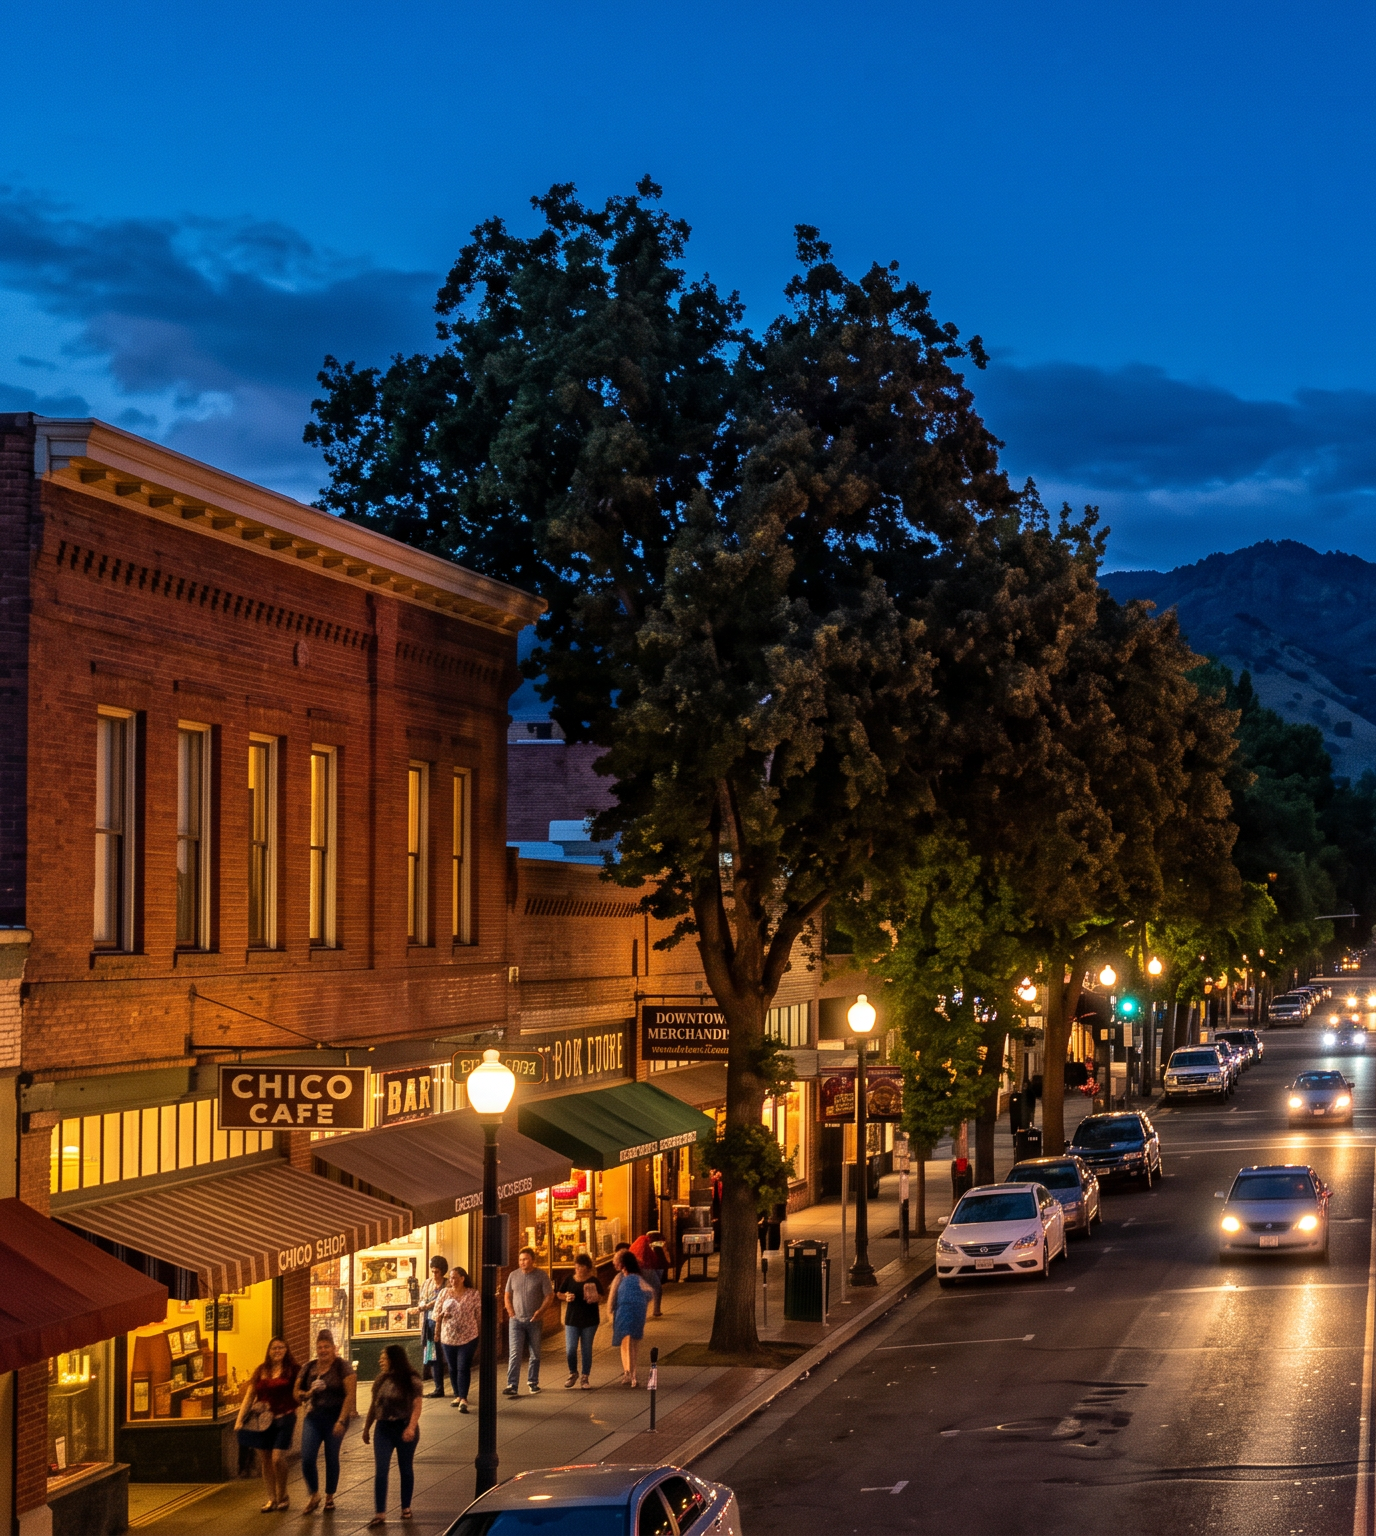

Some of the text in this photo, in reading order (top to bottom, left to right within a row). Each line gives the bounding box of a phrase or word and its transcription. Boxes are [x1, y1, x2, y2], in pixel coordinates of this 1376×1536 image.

[231, 1073, 353, 1100] CHICO
[387, 1075, 430, 1116] BAR
[248, 1103, 334, 1124] CAFE
[278, 1233, 346, 1272] CHICO SHOP
